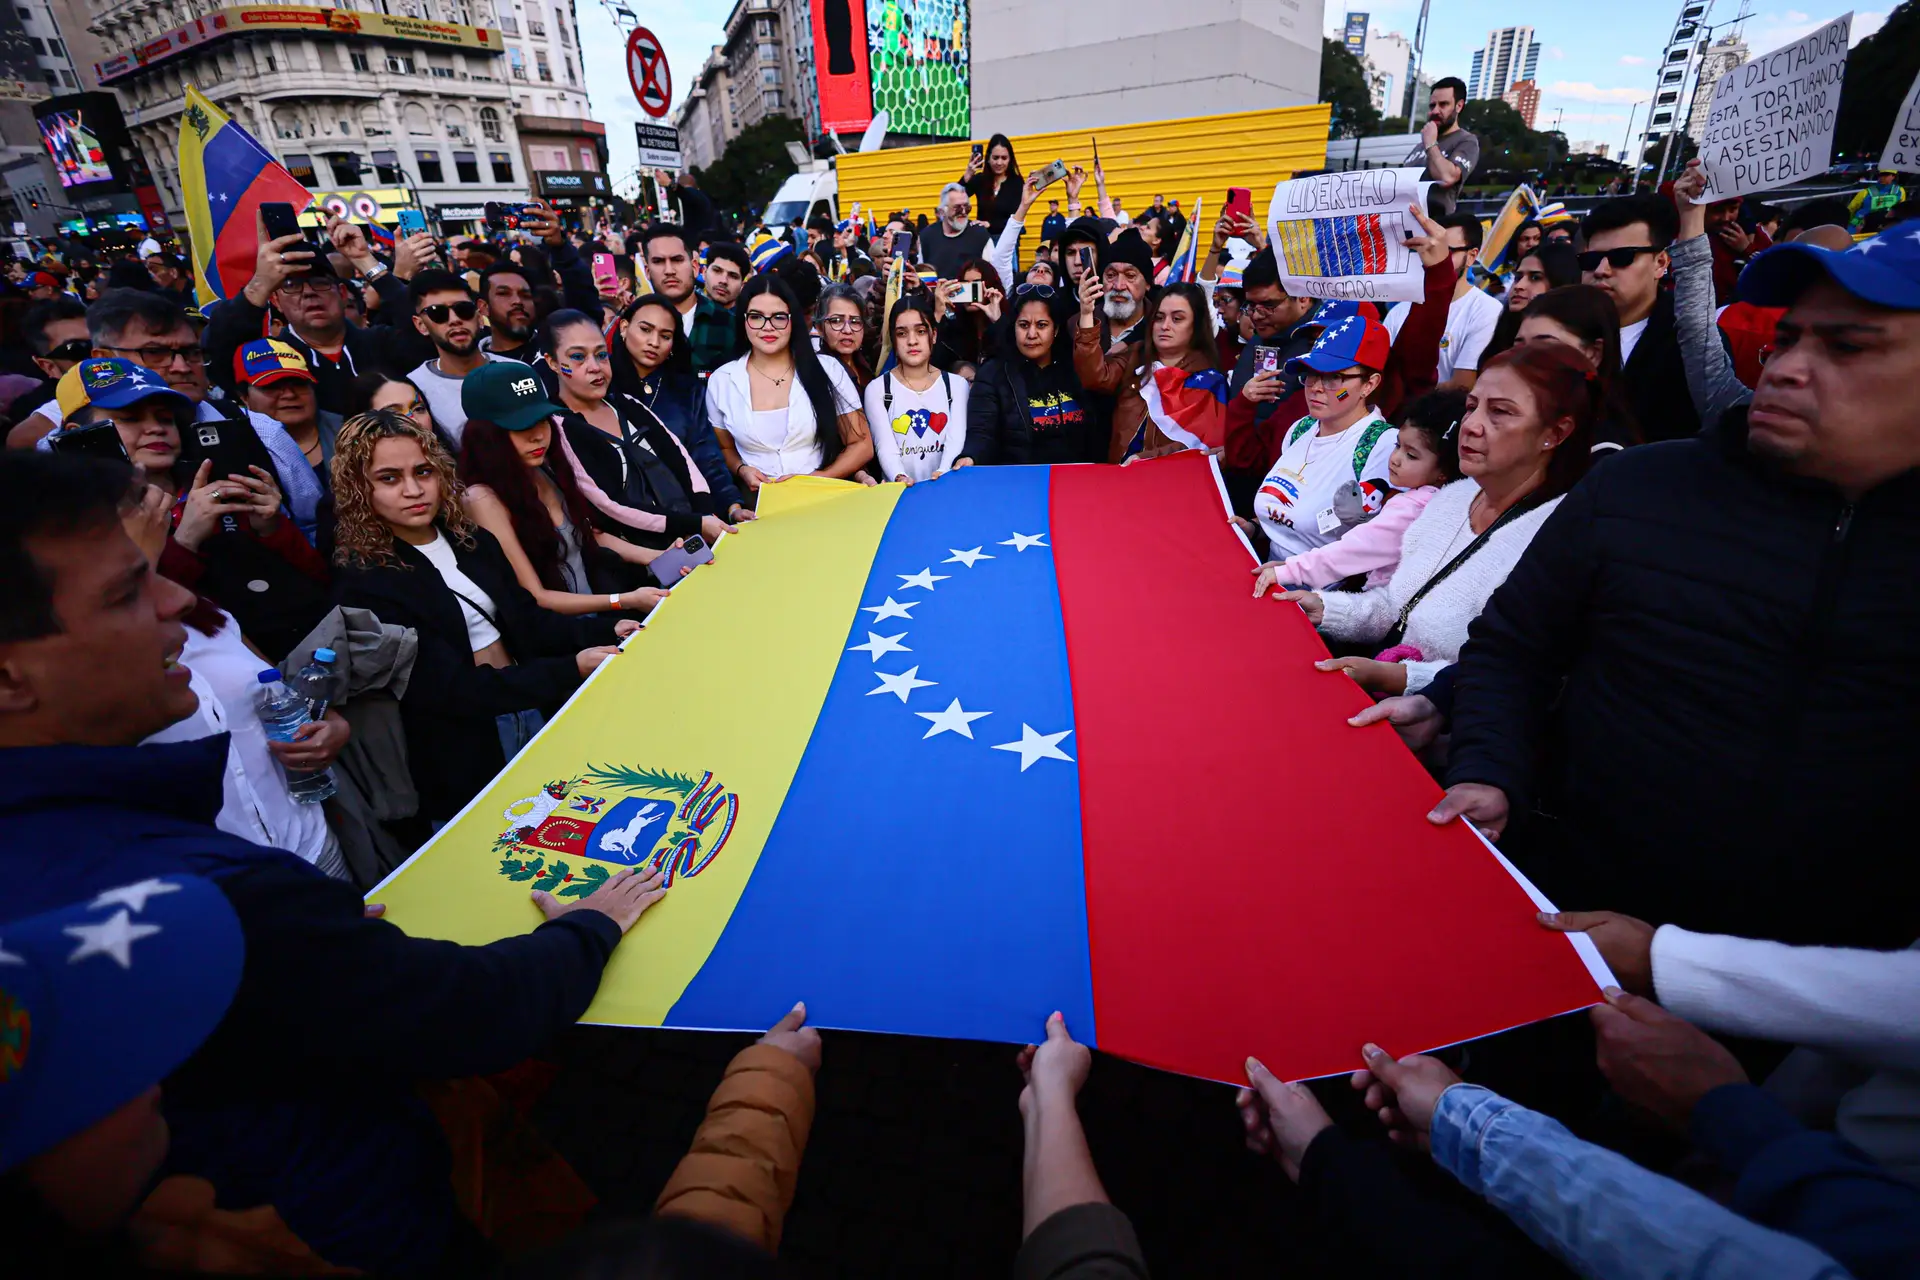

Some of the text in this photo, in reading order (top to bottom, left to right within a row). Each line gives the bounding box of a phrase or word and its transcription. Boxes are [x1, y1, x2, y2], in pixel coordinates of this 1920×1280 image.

[1716, 21, 1848, 99] LA DICTADURA
[637, 126, 645, 134] NO
[1703, 91, 1826, 148] SECUESTRANDO
[1709, 96, 1742, 126] ESTÁ
[1702, 110, 1834, 171] Y ASESINANDO
[1893, 152, 1907, 165] a
[1287, 170, 1397, 213] LIBERTAD
[1701, 147, 1811, 198] AL PUEBLO
